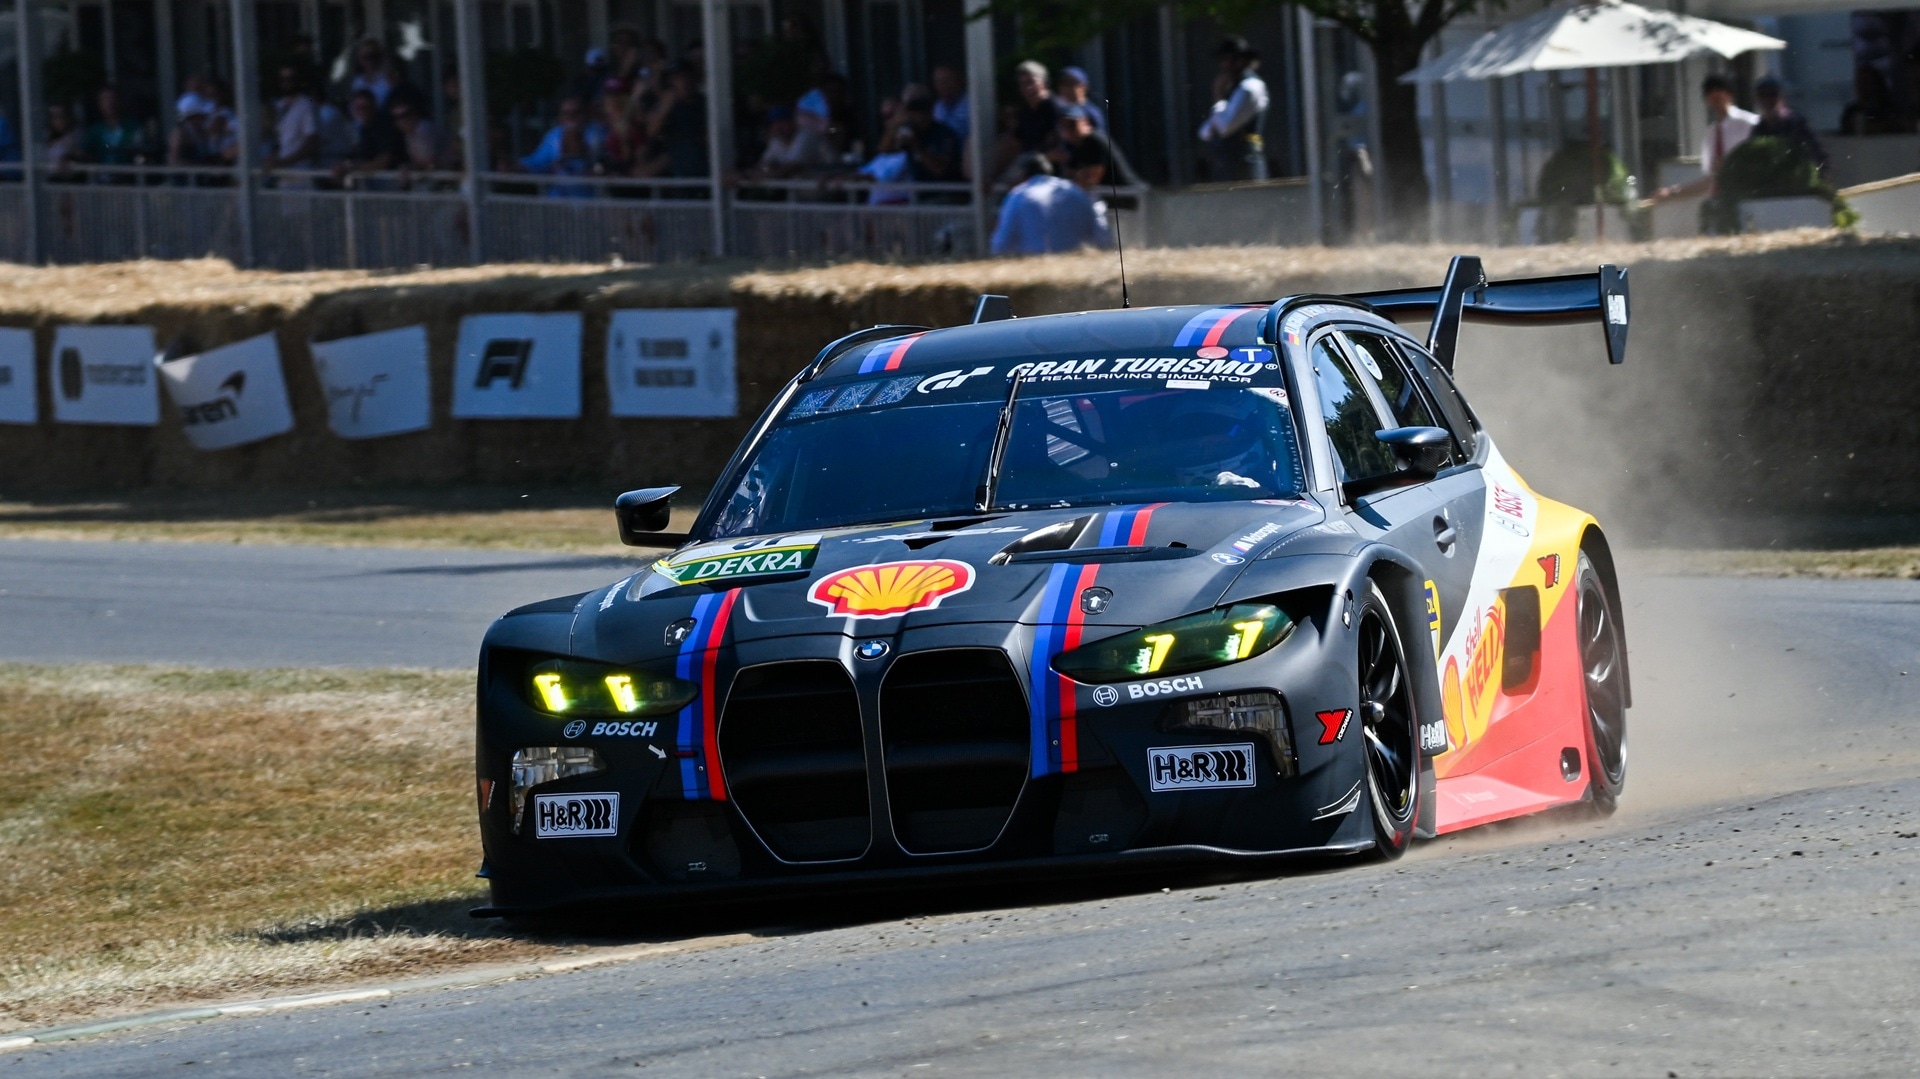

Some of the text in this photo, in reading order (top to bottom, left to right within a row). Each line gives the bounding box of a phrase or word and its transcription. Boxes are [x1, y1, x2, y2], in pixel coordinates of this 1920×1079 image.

[1238, 348, 1263, 362] T
[1006, 358, 1106, 378] GRAN
[1041, 374, 1083, 382] REAL
[1088, 372, 1153, 381] DRIVING
[1157, 372, 1252, 384] SIMULATOR
[694, 551, 803, 579] DEKRA
[1465, 606, 1482, 668] Shell
[1466, 605, 1505, 720] HELIX
[1128, 676, 1204, 699] BOSCH
[591, 721, 658, 737] BOSCH
[1153, 752, 1217, 784] H&R
[539, 800, 586, 831] H&R
